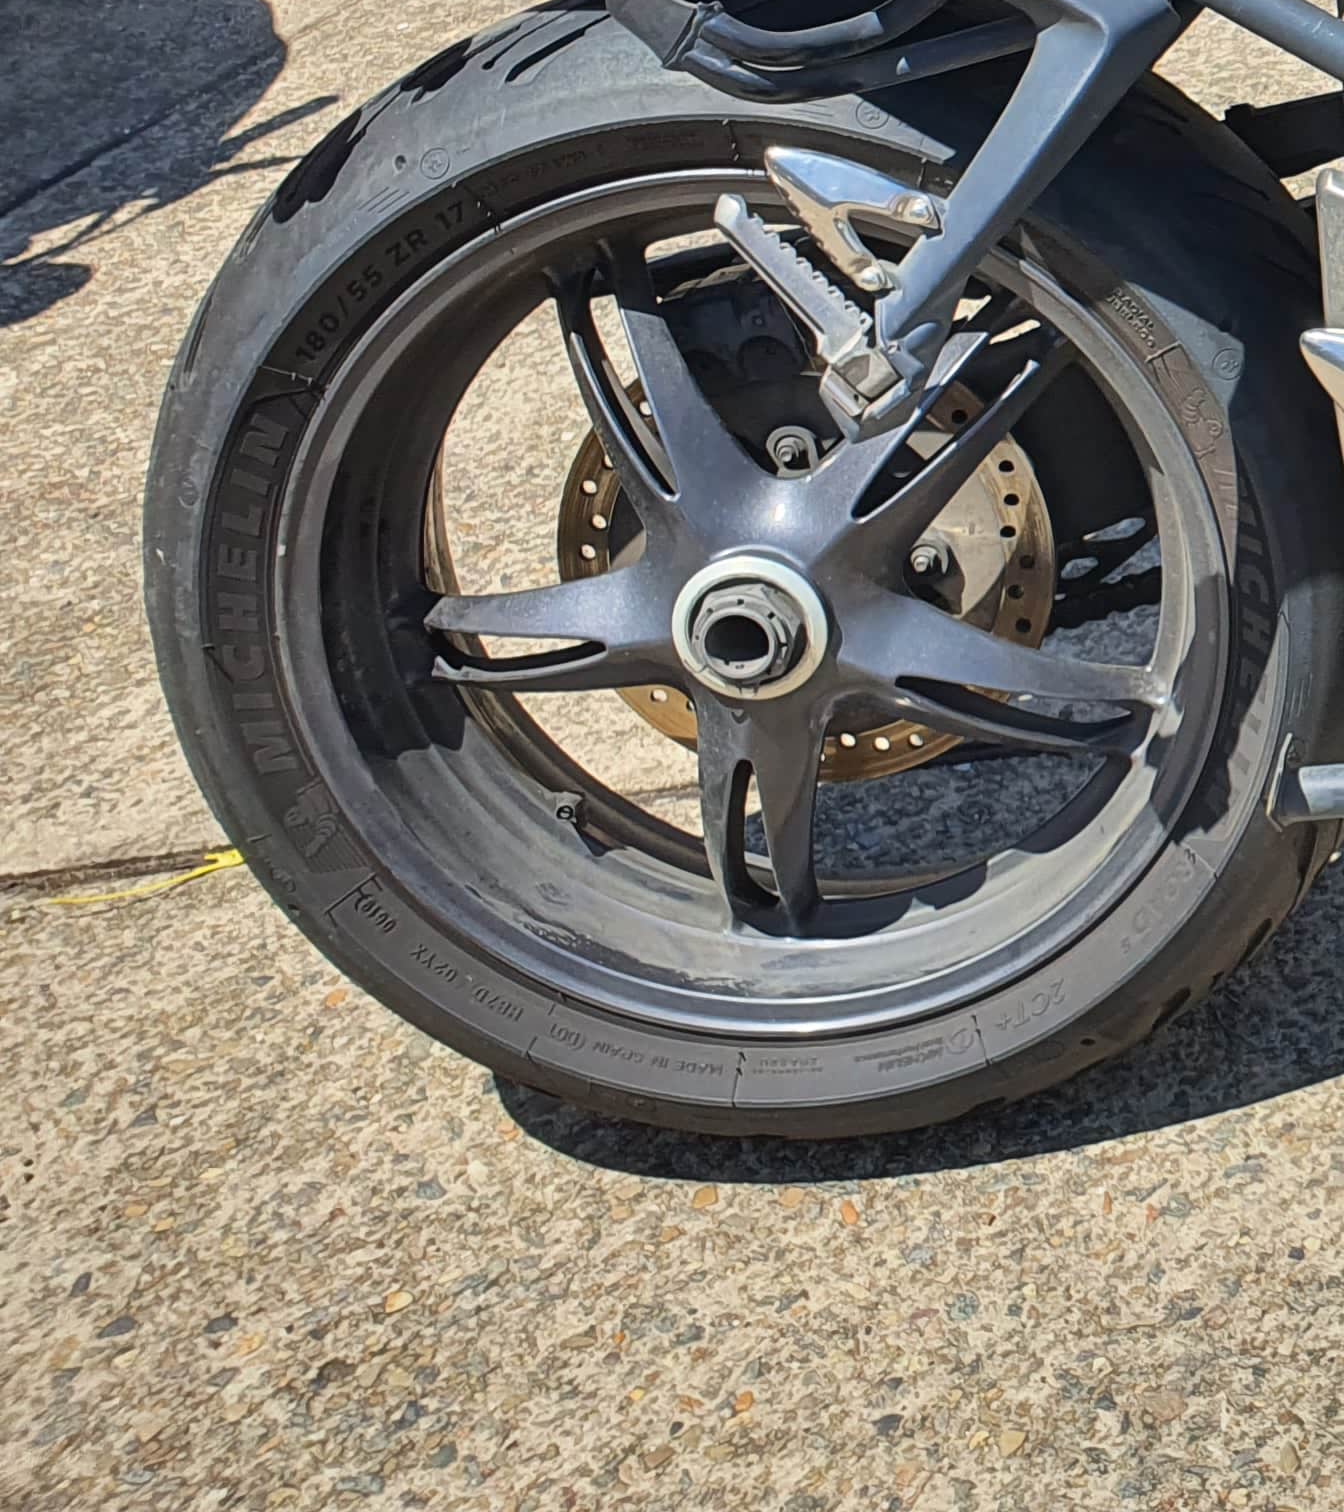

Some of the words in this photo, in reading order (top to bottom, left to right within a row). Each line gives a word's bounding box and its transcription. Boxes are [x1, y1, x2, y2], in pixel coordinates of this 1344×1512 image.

[294, 264, 386, 368] 180/55
[386, 227, 429, 271] ZR
[433, 201, 466, 234] 17
[214, 411, 300, 778] MICHELIN
